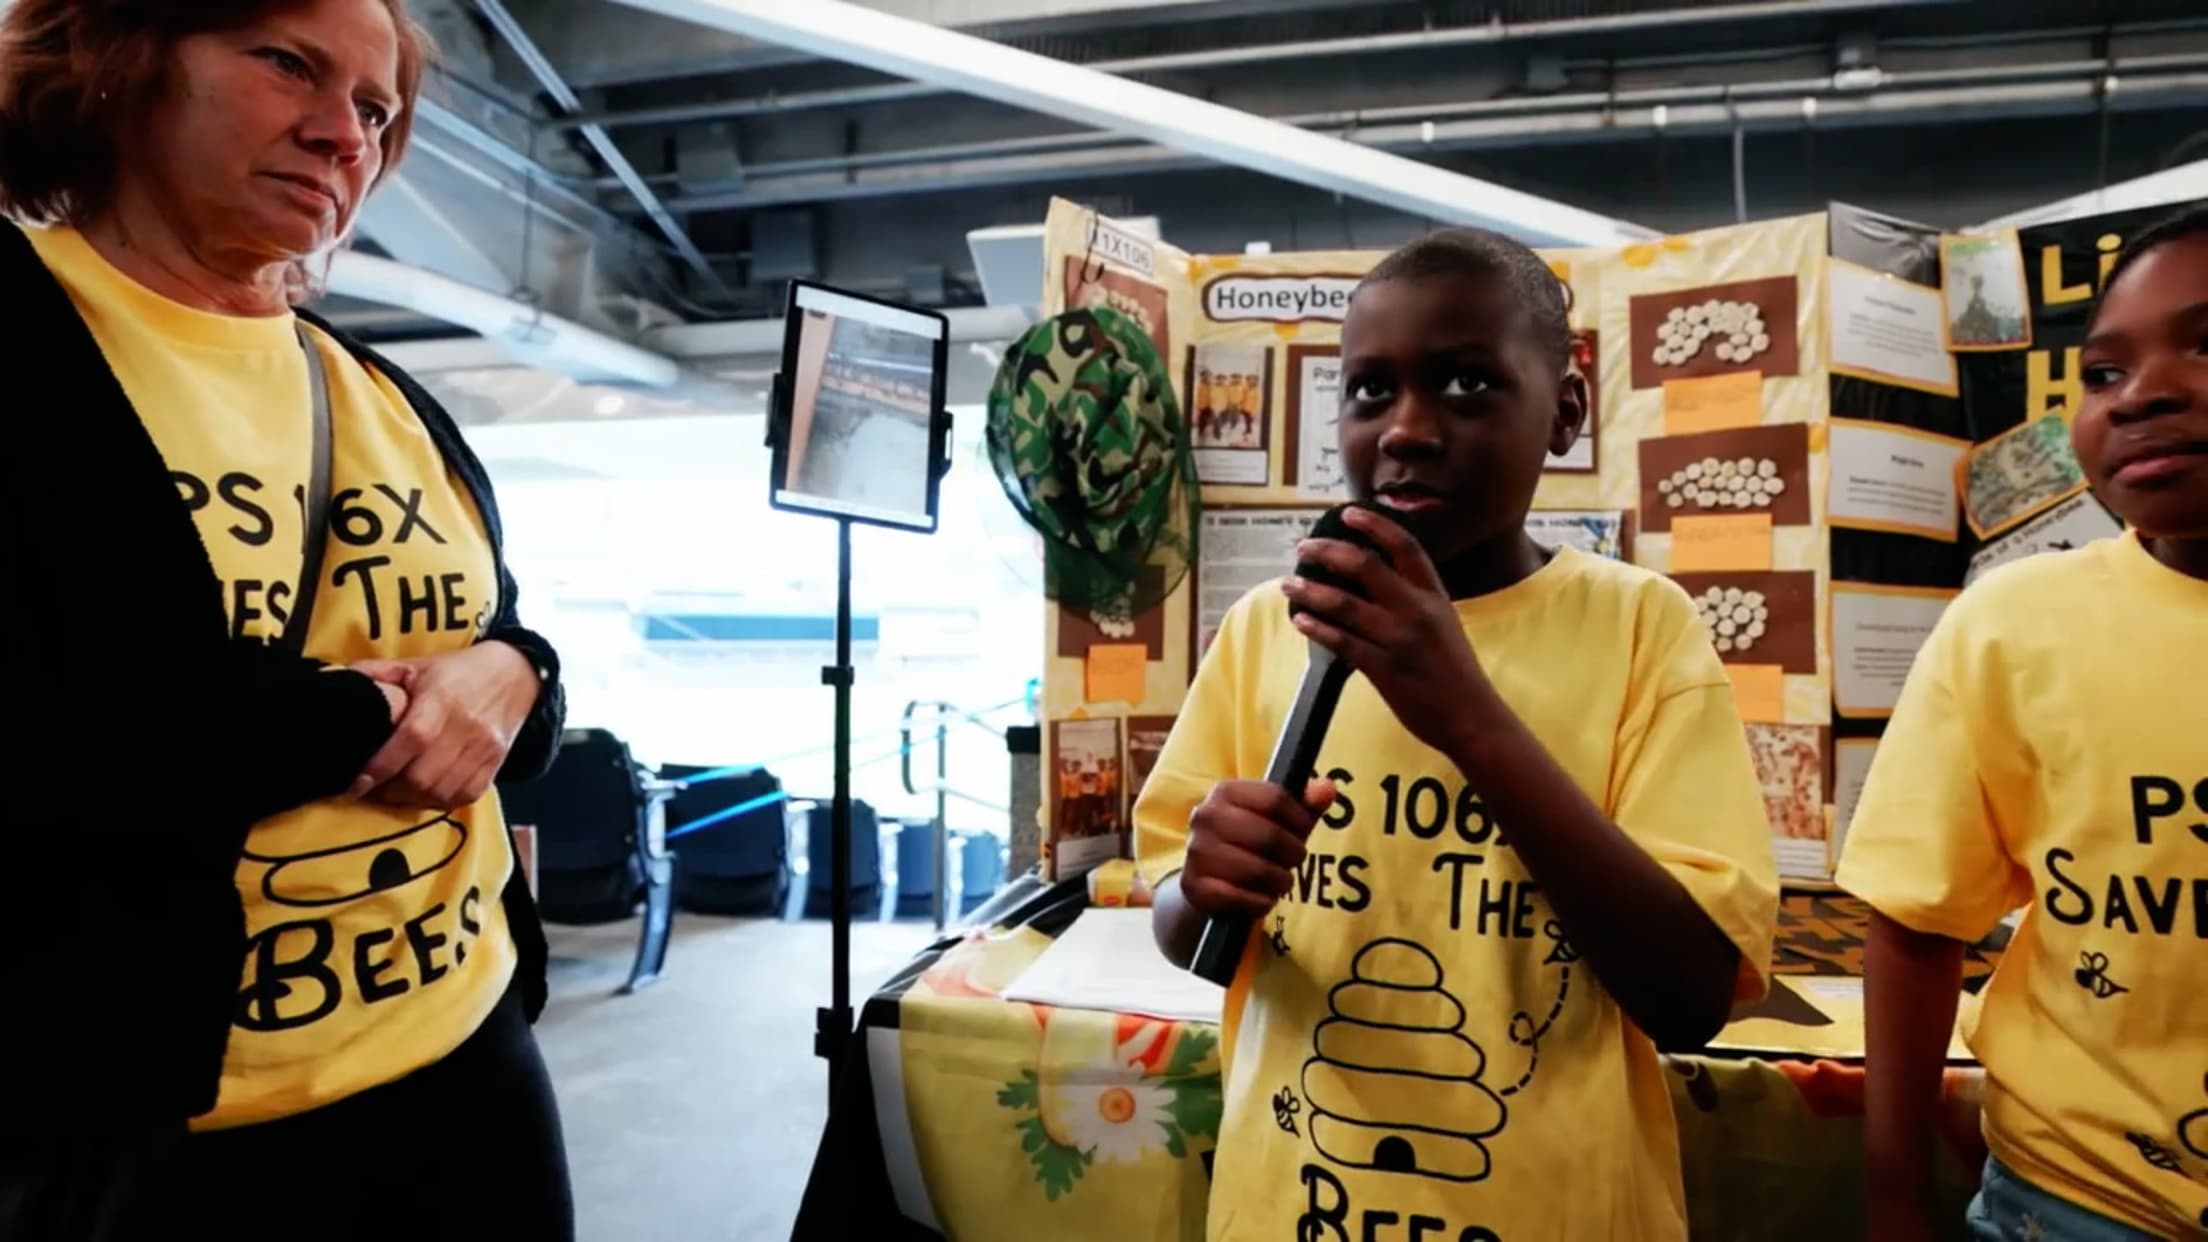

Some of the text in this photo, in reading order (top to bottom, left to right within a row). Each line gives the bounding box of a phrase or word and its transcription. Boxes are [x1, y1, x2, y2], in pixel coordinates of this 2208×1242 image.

[332, 555, 469, 640] THE
[1380, 774, 1509, 846] 106
[1432, 852, 1538, 939] THE
